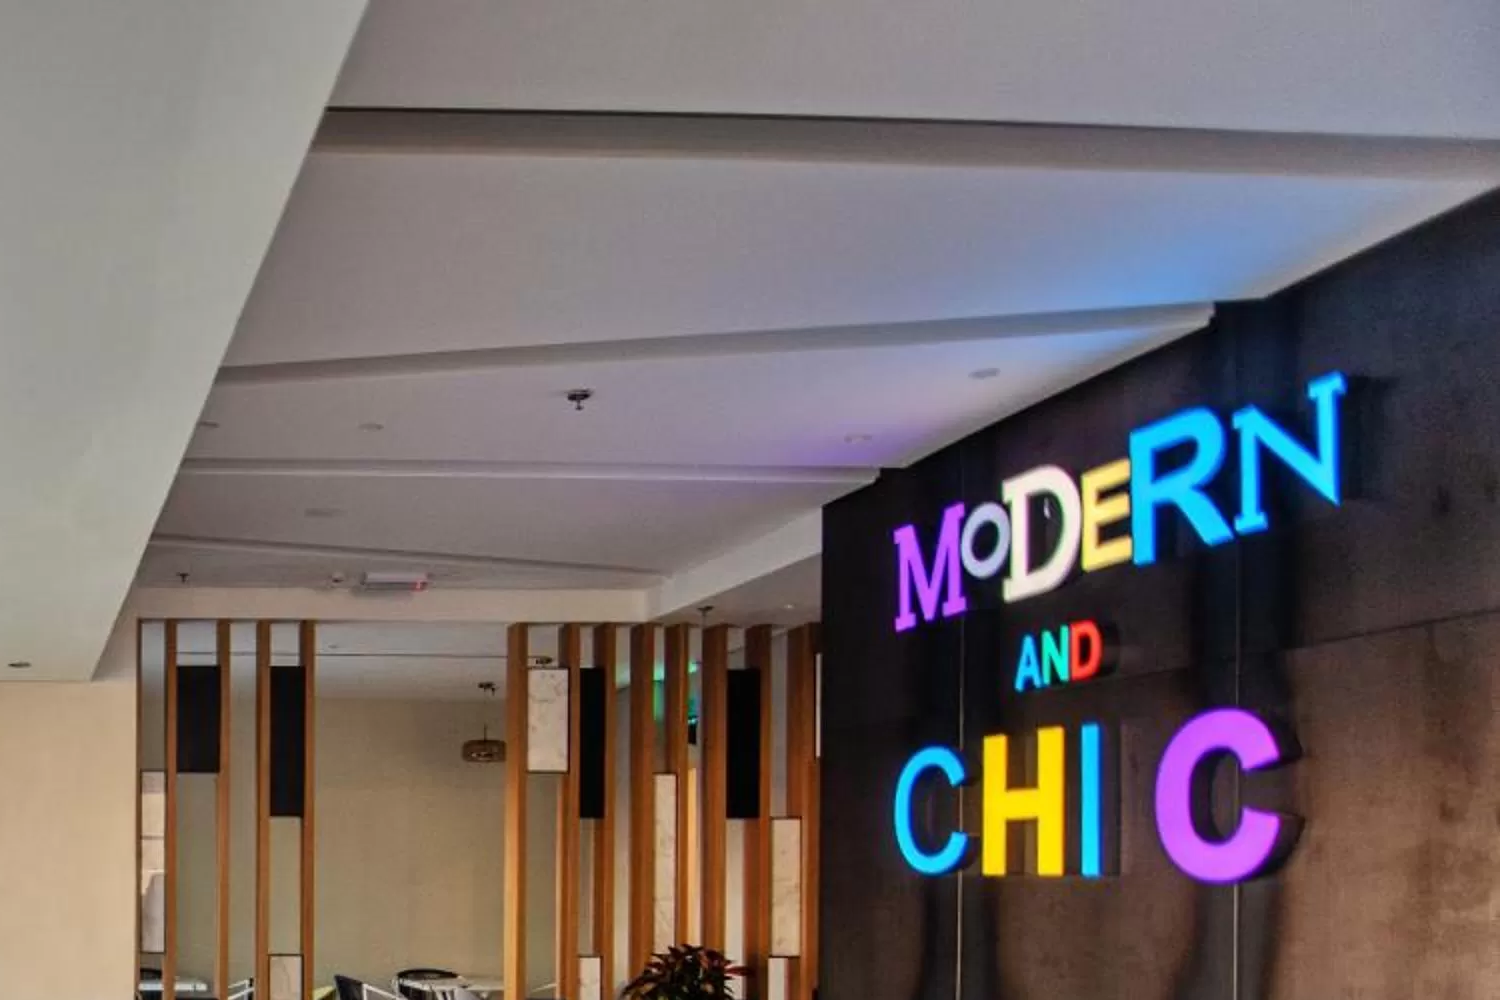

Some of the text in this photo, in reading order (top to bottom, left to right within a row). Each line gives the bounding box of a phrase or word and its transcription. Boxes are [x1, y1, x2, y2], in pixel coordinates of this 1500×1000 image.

[893, 371, 1348, 632] MODERN
[1014, 619, 1102, 692] AND
[894, 708, 1281, 884] CHIC
